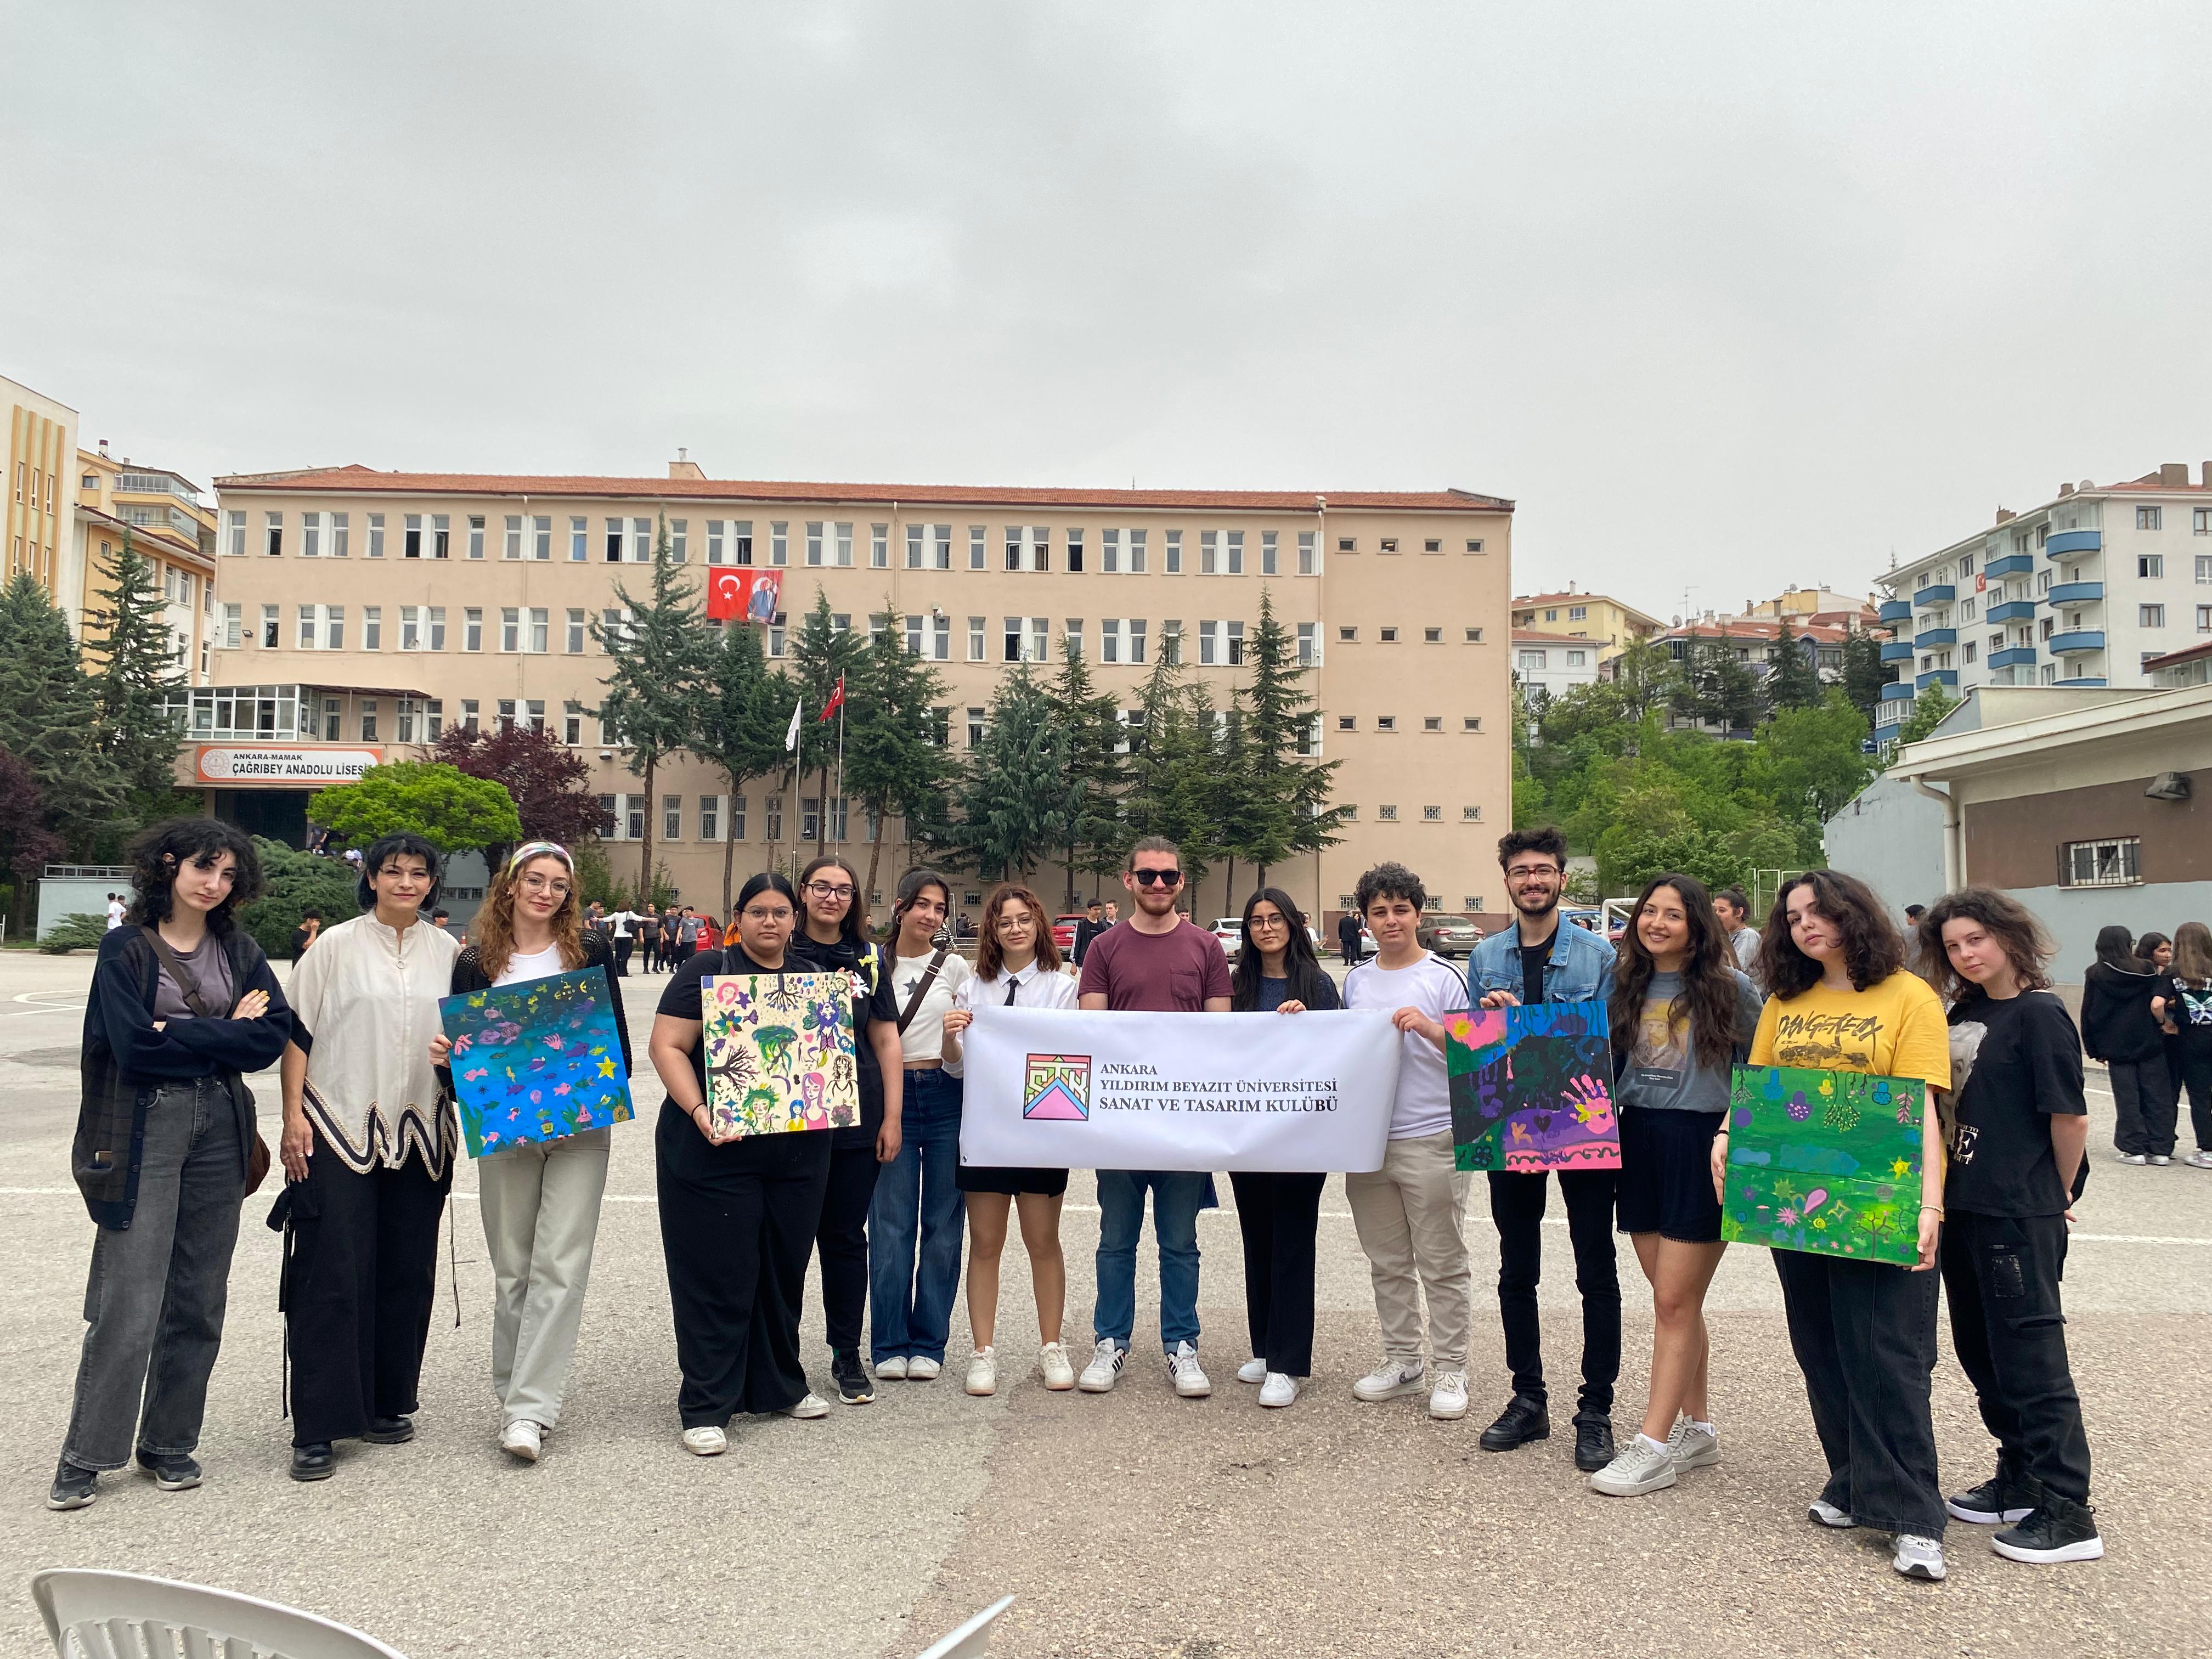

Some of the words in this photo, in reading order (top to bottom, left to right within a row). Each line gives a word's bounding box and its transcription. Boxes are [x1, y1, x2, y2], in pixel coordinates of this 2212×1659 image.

[233, 761, 283, 776] ÇAĞRIBEY
[286, 764, 332, 775] ANADOLU
[336, 763, 366, 775] LİSESİ
[1101, 1063, 1158, 1075] ANKARA
[1101, 1080, 1169, 1091] YILDIRIM
[1173, 1081, 1232, 1092] BEYAZIT
[1236, 1077, 1337, 1092] ÜNİVERSİTESİ
[1099, 1097, 1153, 1110] SANAT
[1157, 1099, 1180, 1111] VE
[1184, 1099, 1261, 1112] TASARIM
[1266, 1096, 1338, 1111] KULÜBÜ
